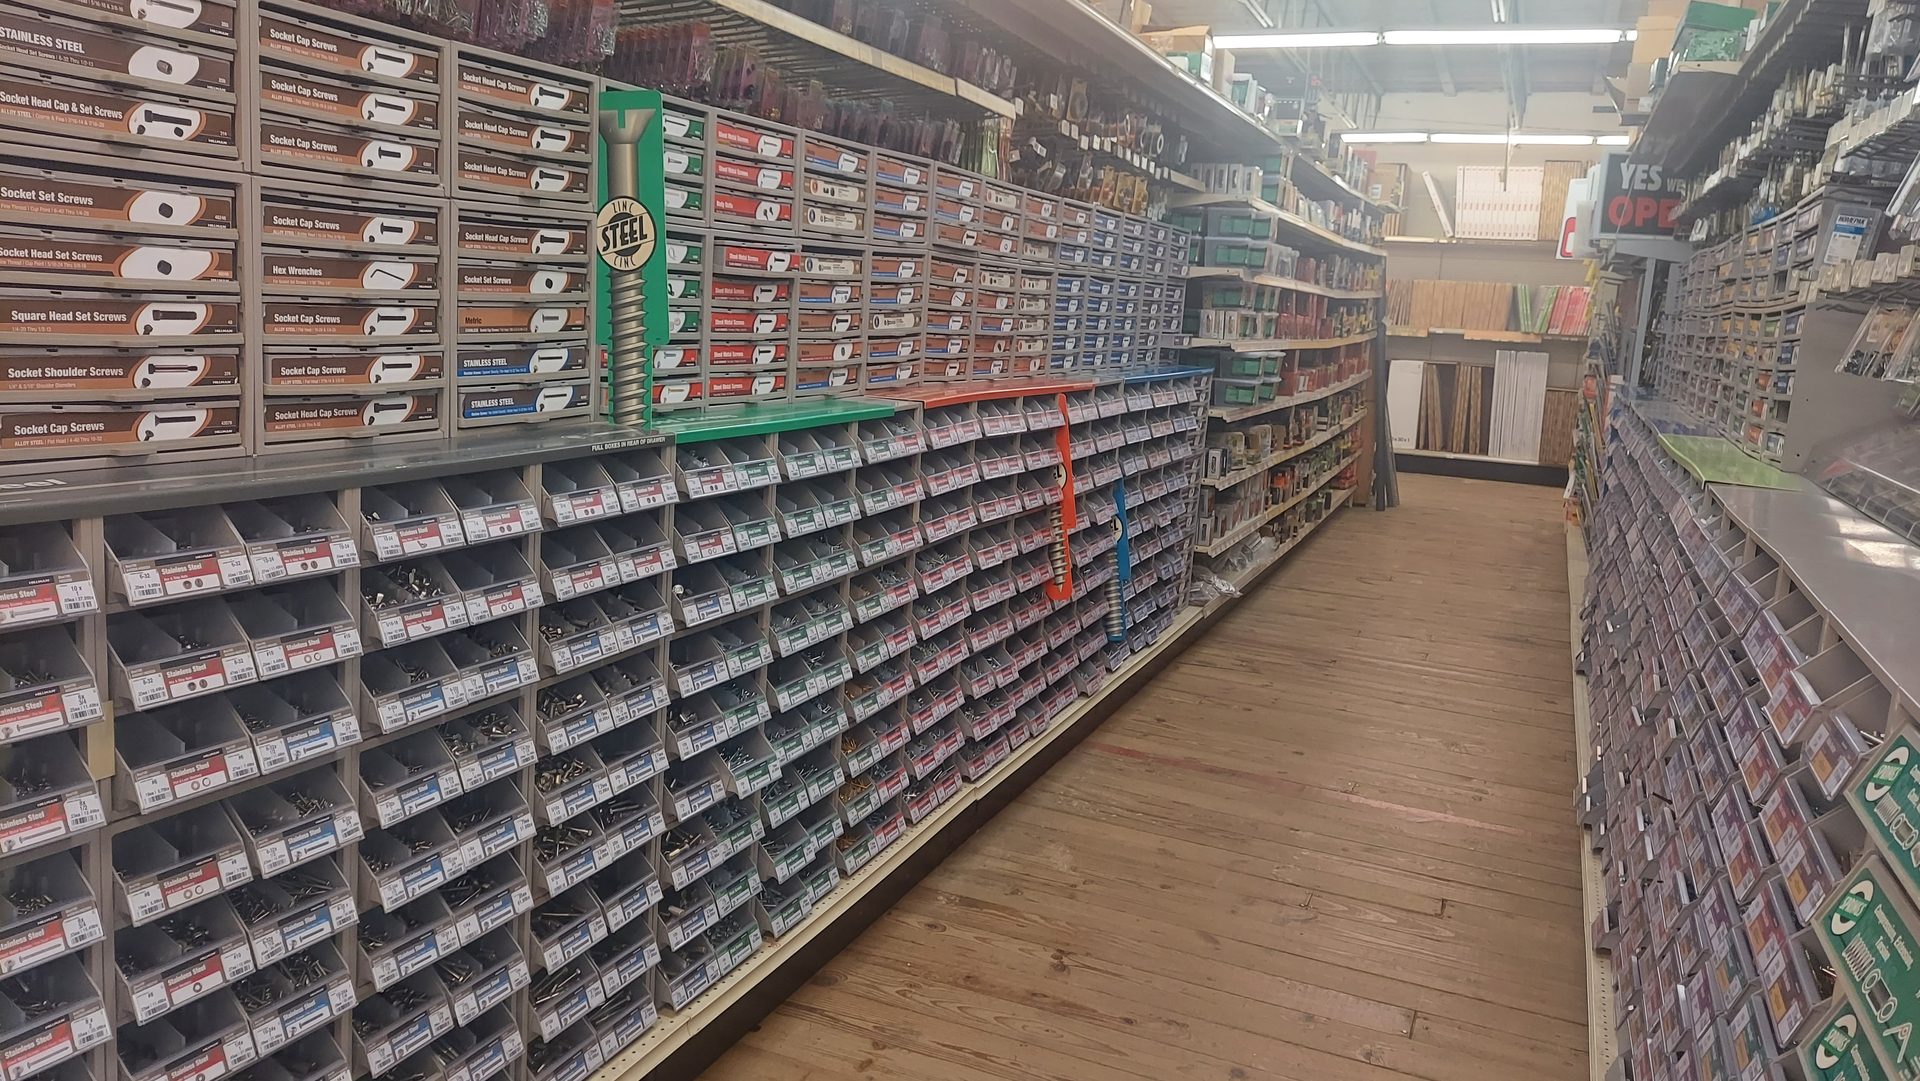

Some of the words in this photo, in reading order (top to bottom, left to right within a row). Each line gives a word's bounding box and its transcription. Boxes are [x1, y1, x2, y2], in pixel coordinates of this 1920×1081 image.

[0, 27, 53, 47] STAINLESS
[55, 38, 85, 53] STEEL
[270, 29, 295, 42] Socket
[297, 34, 310, 47] Cap
[312, 38, 338, 52] Screws
[463, 72, 482, 84] Socket
[482, 77, 496, 86] Head
[497, 80, 507, 90] Cap
[508, 83, 526, 93] Screws
[272, 80, 296, 93] Socket
[298, 85, 311, 97] Cap
[313, 88, 338, 102] Screws
[0, 91, 29, 105] Socket
[32, 97, 52, 109] Head
[54, 100, 69, 113] Cap
[71, 103, 78, 112] &
[80, 104, 92, 115] Set
[95, 106, 122, 119] Screws
[465, 120, 483, 129] Socket
[484, 123, 497, 132] Head
[498, 126, 508, 135] Cap
[510, 127, 528, 137] Screws
[270, 134, 295, 146] Socket
[297, 139, 310, 150] Cap
[312, 141, 337, 152] Screws
[465, 162, 482, 171] Socket
[484, 165, 496, 173] Head
[498, 167, 507, 176] Cap
[509, 169, 526, 178] Screws
[1621, 162, 1662, 191] YES
[1, 187, 36, 200] Socket
[39, 191, 55, 201] Set
[58, 193, 93, 205] Screws
[1608, 196, 1681, 228] OPE
[273, 216, 298, 226] Socket
[300, 219, 312, 228] Cap
[314, 220, 340, 230] Screws
[465, 233, 483, 241] Socket
[499, 234, 509, 243] Cap
[510, 235, 528, 243] Screws
[602, 216, 648, 252] STEEL
[0, 247, 28, 257] Socket
[31, 250, 53, 259] Head
[55, 250, 69, 260] Set
[72, 251, 102, 261] Screws
[273, 266, 286, 274] Hex
[288, 266, 322, 276] Wrenches
[464, 276, 482, 284] Socket
[12, 310, 46, 322] Square
[49, 311, 72, 321] Head
[75, 312, 91, 321] Set
[94, 312, 127, 322] Screws
[274, 314, 298, 322] Socket
[300, 314, 314, 324] Cap
[315, 315, 340, 323] Screws
[464, 359, 491, 367] STAINLESS
[8, 368, 42, 378] Socket
[45, 367, 87, 377] Shoulder
[90, 367, 123, 376] Screws
[281, 367, 305, 375] Socket
[307, 367, 320, 376] Cap
[322, 366, 346, 374] Screws
[471, 400, 498, 408] STAINLESS
[275, 411, 299, 420] Socket
[319, 409, 332, 418] Cap
[333, 408, 357, 416] Screws
[14, 424, 47, 435] Socket
[50, 424, 67, 434] Cap
[70, 423, 104, 432] Screws
[161, 564, 187, 575] Stainless
[167, 667, 192, 678] Stainless
[193, 664, 207, 673] Steel
[26, 701, 42, 710] Steel
[171, 767, 195, 778] Stainless
[196, 762, 210, 771] Steel
[28, 811, 44, 821] Steel
[164, 876, 188, 888] Stainless
[189, 871, 203, 880] Steel
[28, 929, 44, 940] Steel
[5, 1041, 35, 1059] Stainless
[36, 1033, 52, 1044] Steel
